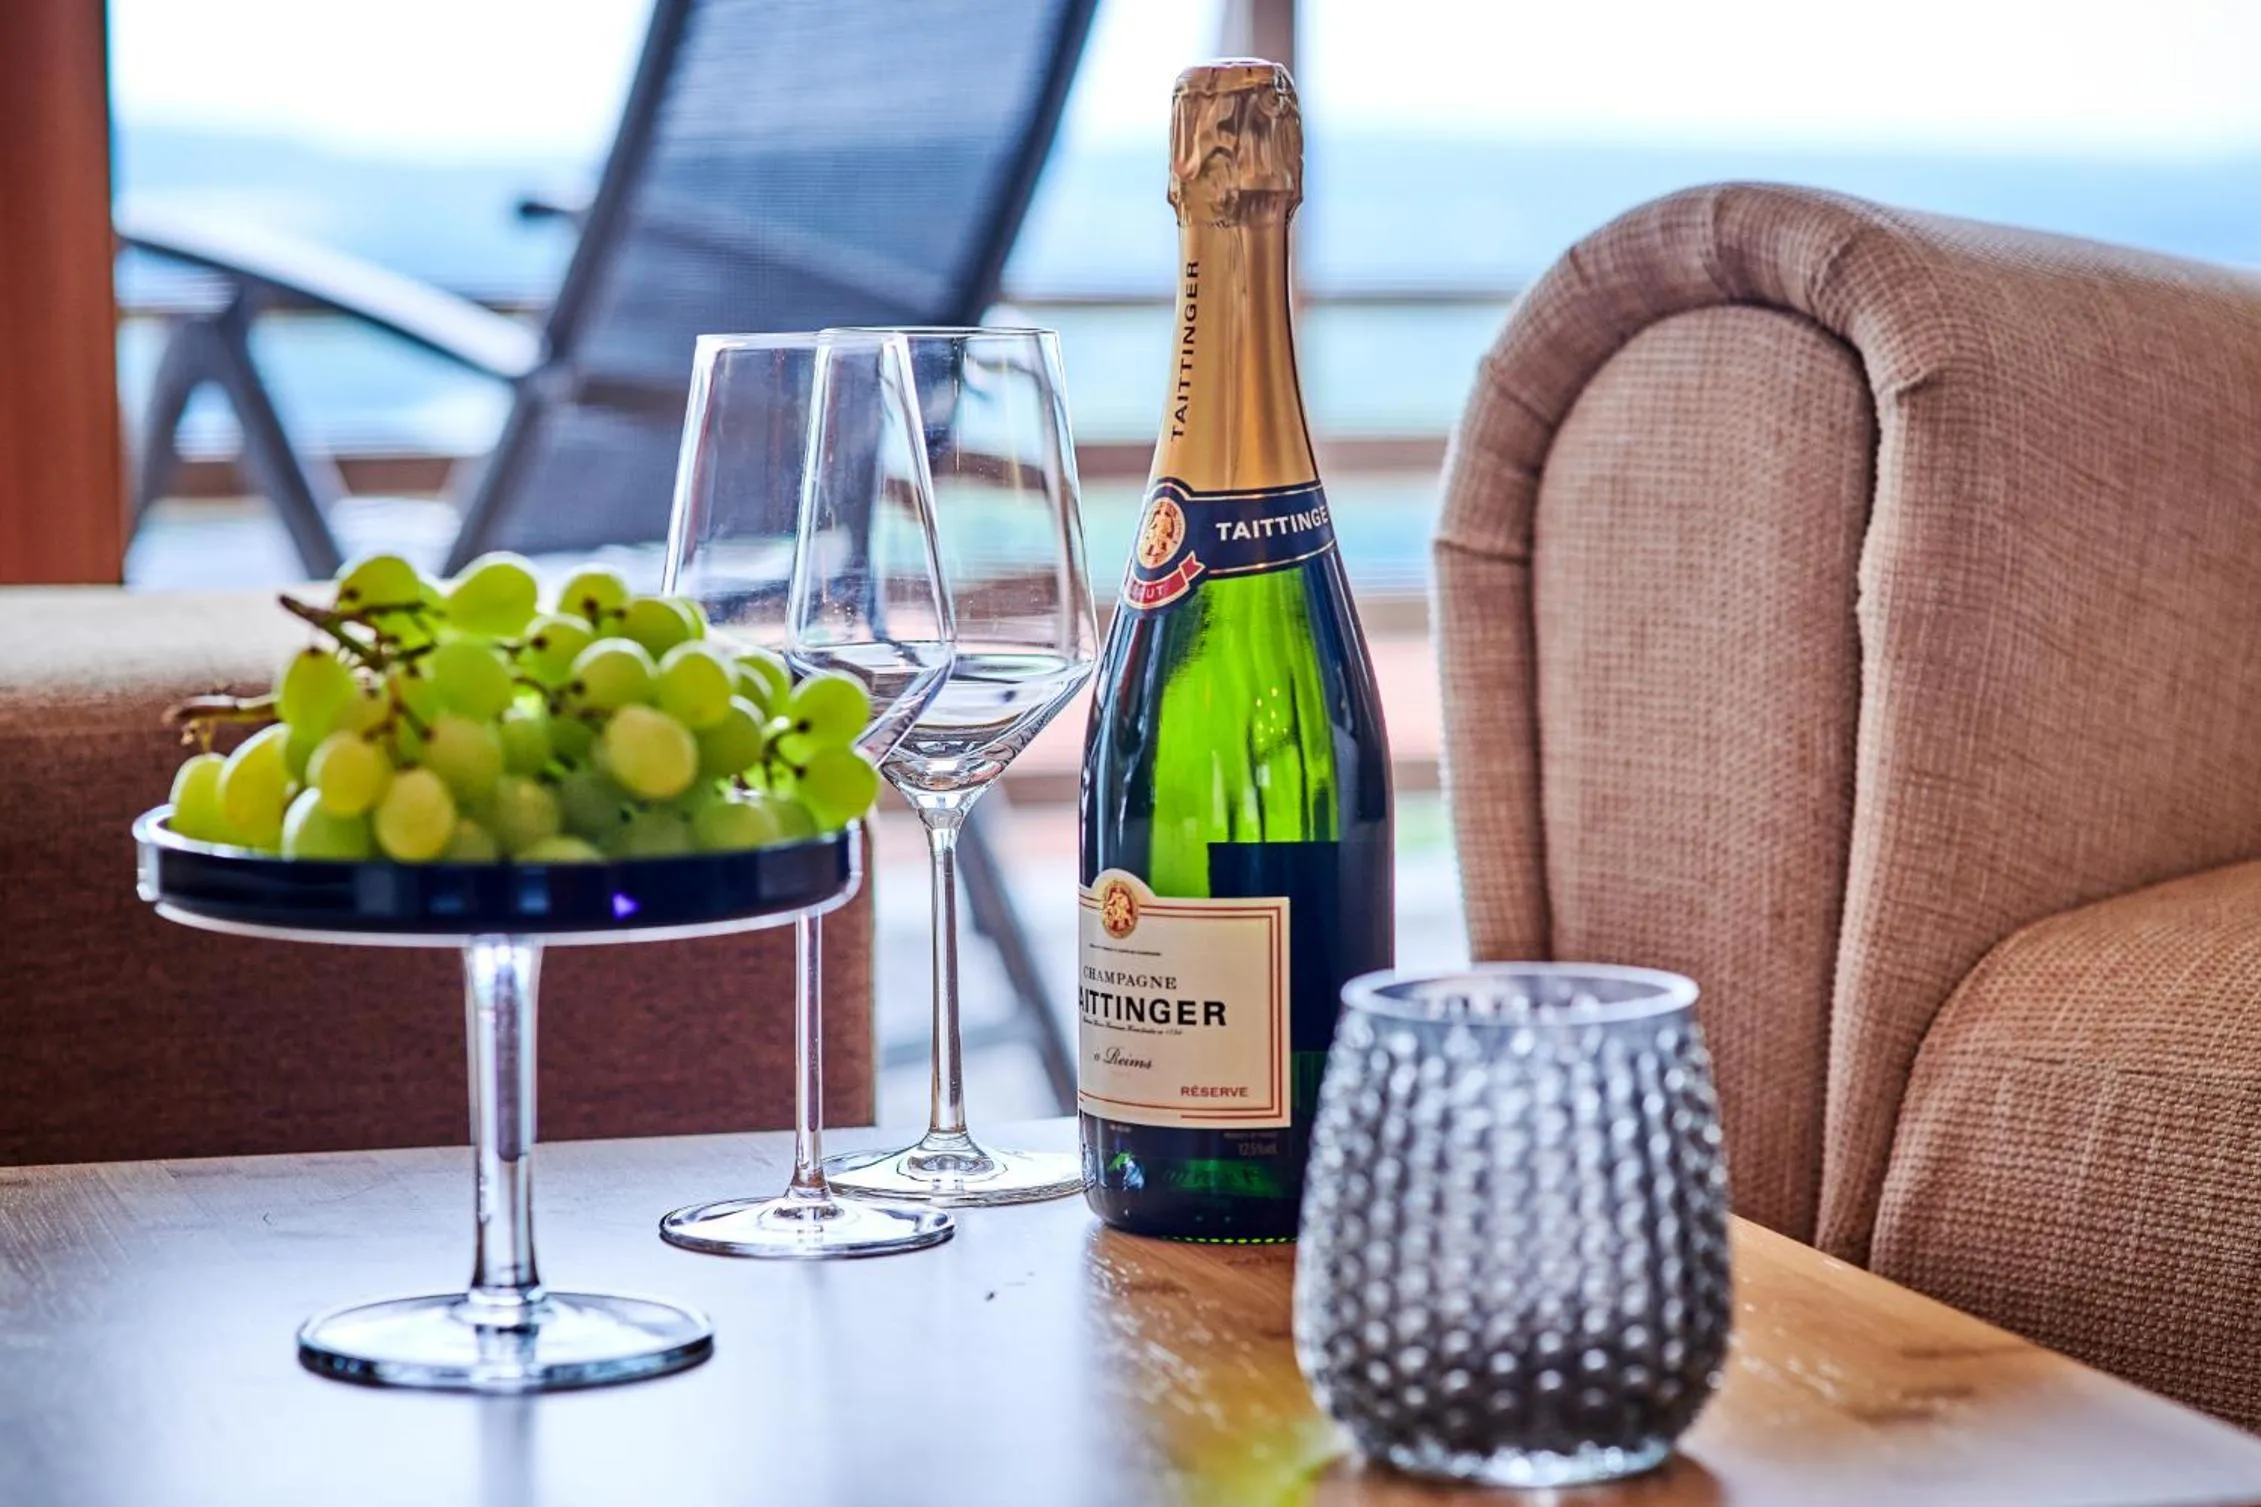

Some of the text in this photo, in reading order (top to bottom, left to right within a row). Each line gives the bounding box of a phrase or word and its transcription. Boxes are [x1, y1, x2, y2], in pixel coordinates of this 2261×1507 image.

[1171, 261, 1199, 441] TAITTINGER
[1216, 506, 1329, 541] TAITTINGE
[1083, 965, 1177, 990] CHAMPAGNE
[1079, 985, 1227, 1027] AITTINGER
[1103, 1047, 1152, 1070] Reims
[1181, 1083, 1248, 1098] RÉSERVE
